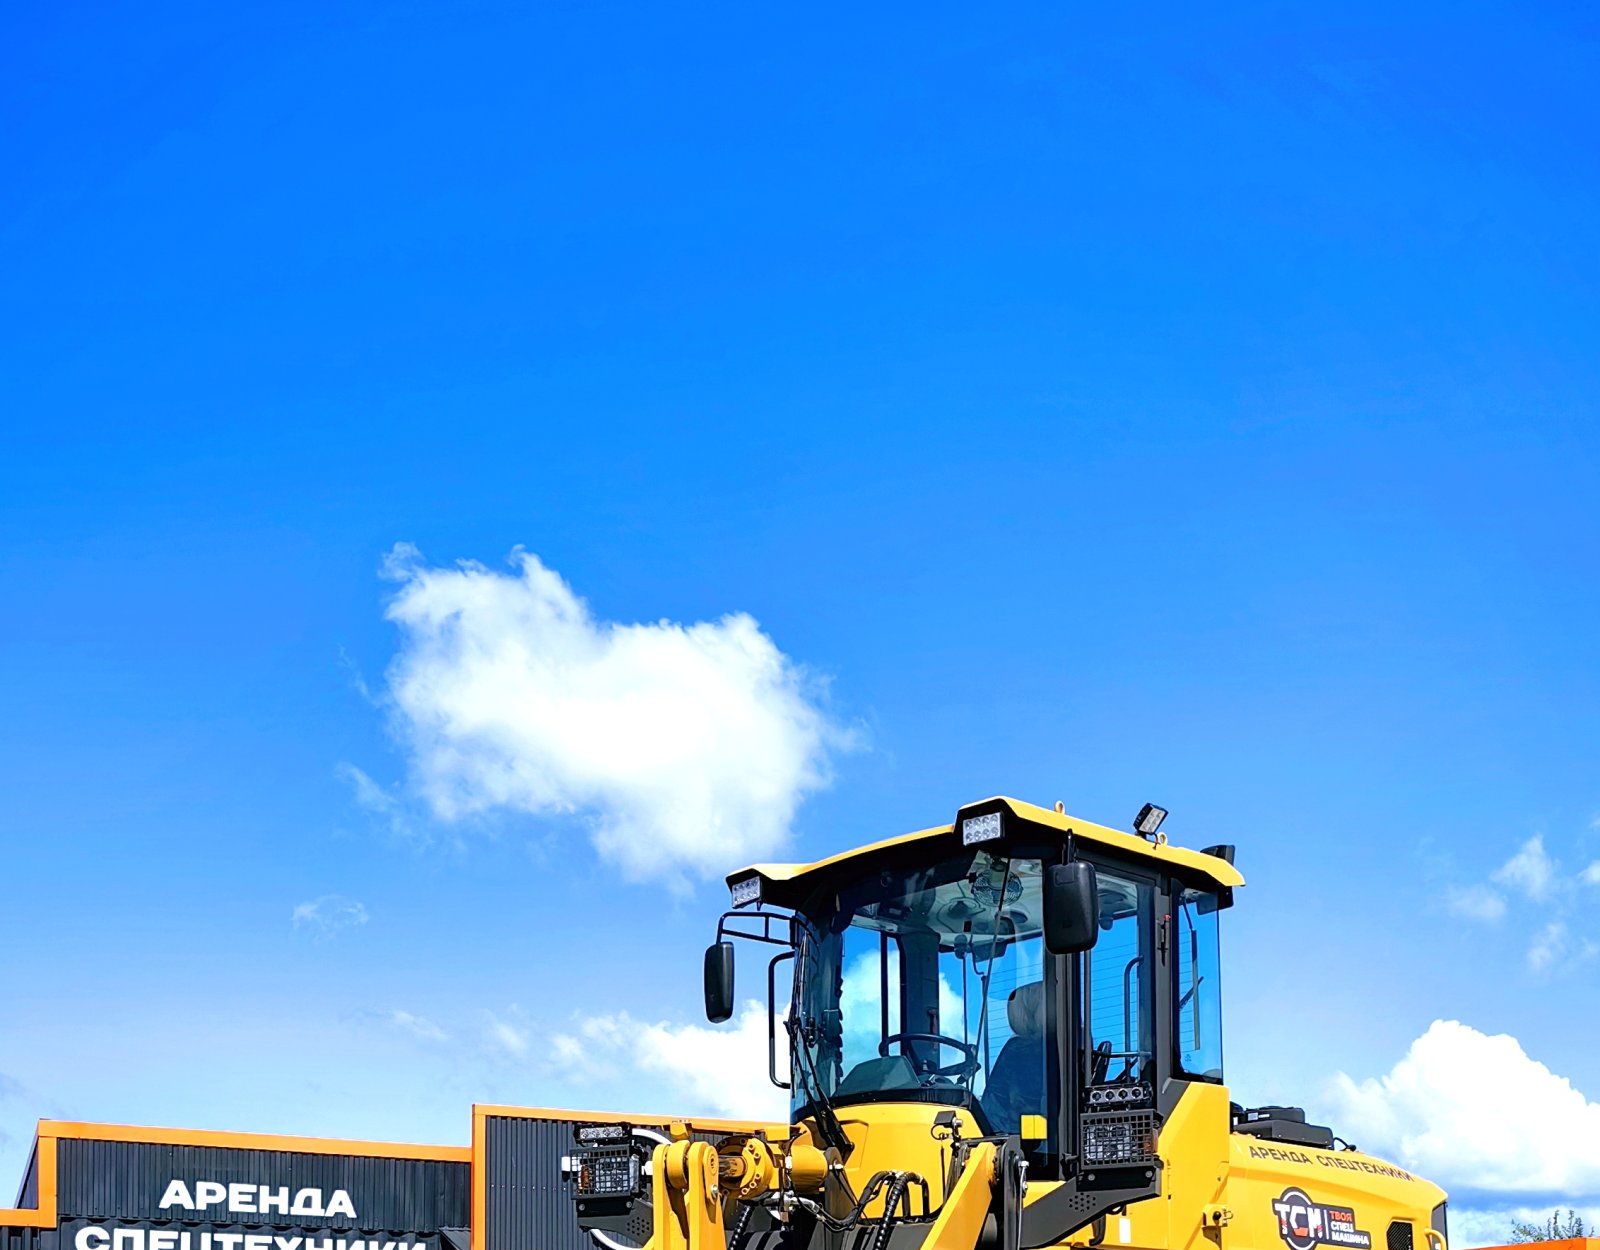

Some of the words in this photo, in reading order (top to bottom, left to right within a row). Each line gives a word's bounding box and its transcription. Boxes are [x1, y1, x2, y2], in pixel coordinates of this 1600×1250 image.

[1248, 1146, 1313, 1165] АРЕНДА
[1316, 1155, 1415, 1183] СПЕЦТЕХНИКИ
[158, 1179, 357, 1219] АРЕНДА
[1329, 1210, 1352, 1222] ТВОЯ
[1330, 1221, 1354, 1233] СПЕЦ
[1331, 1231, 1370, 1245] МАШИНА
